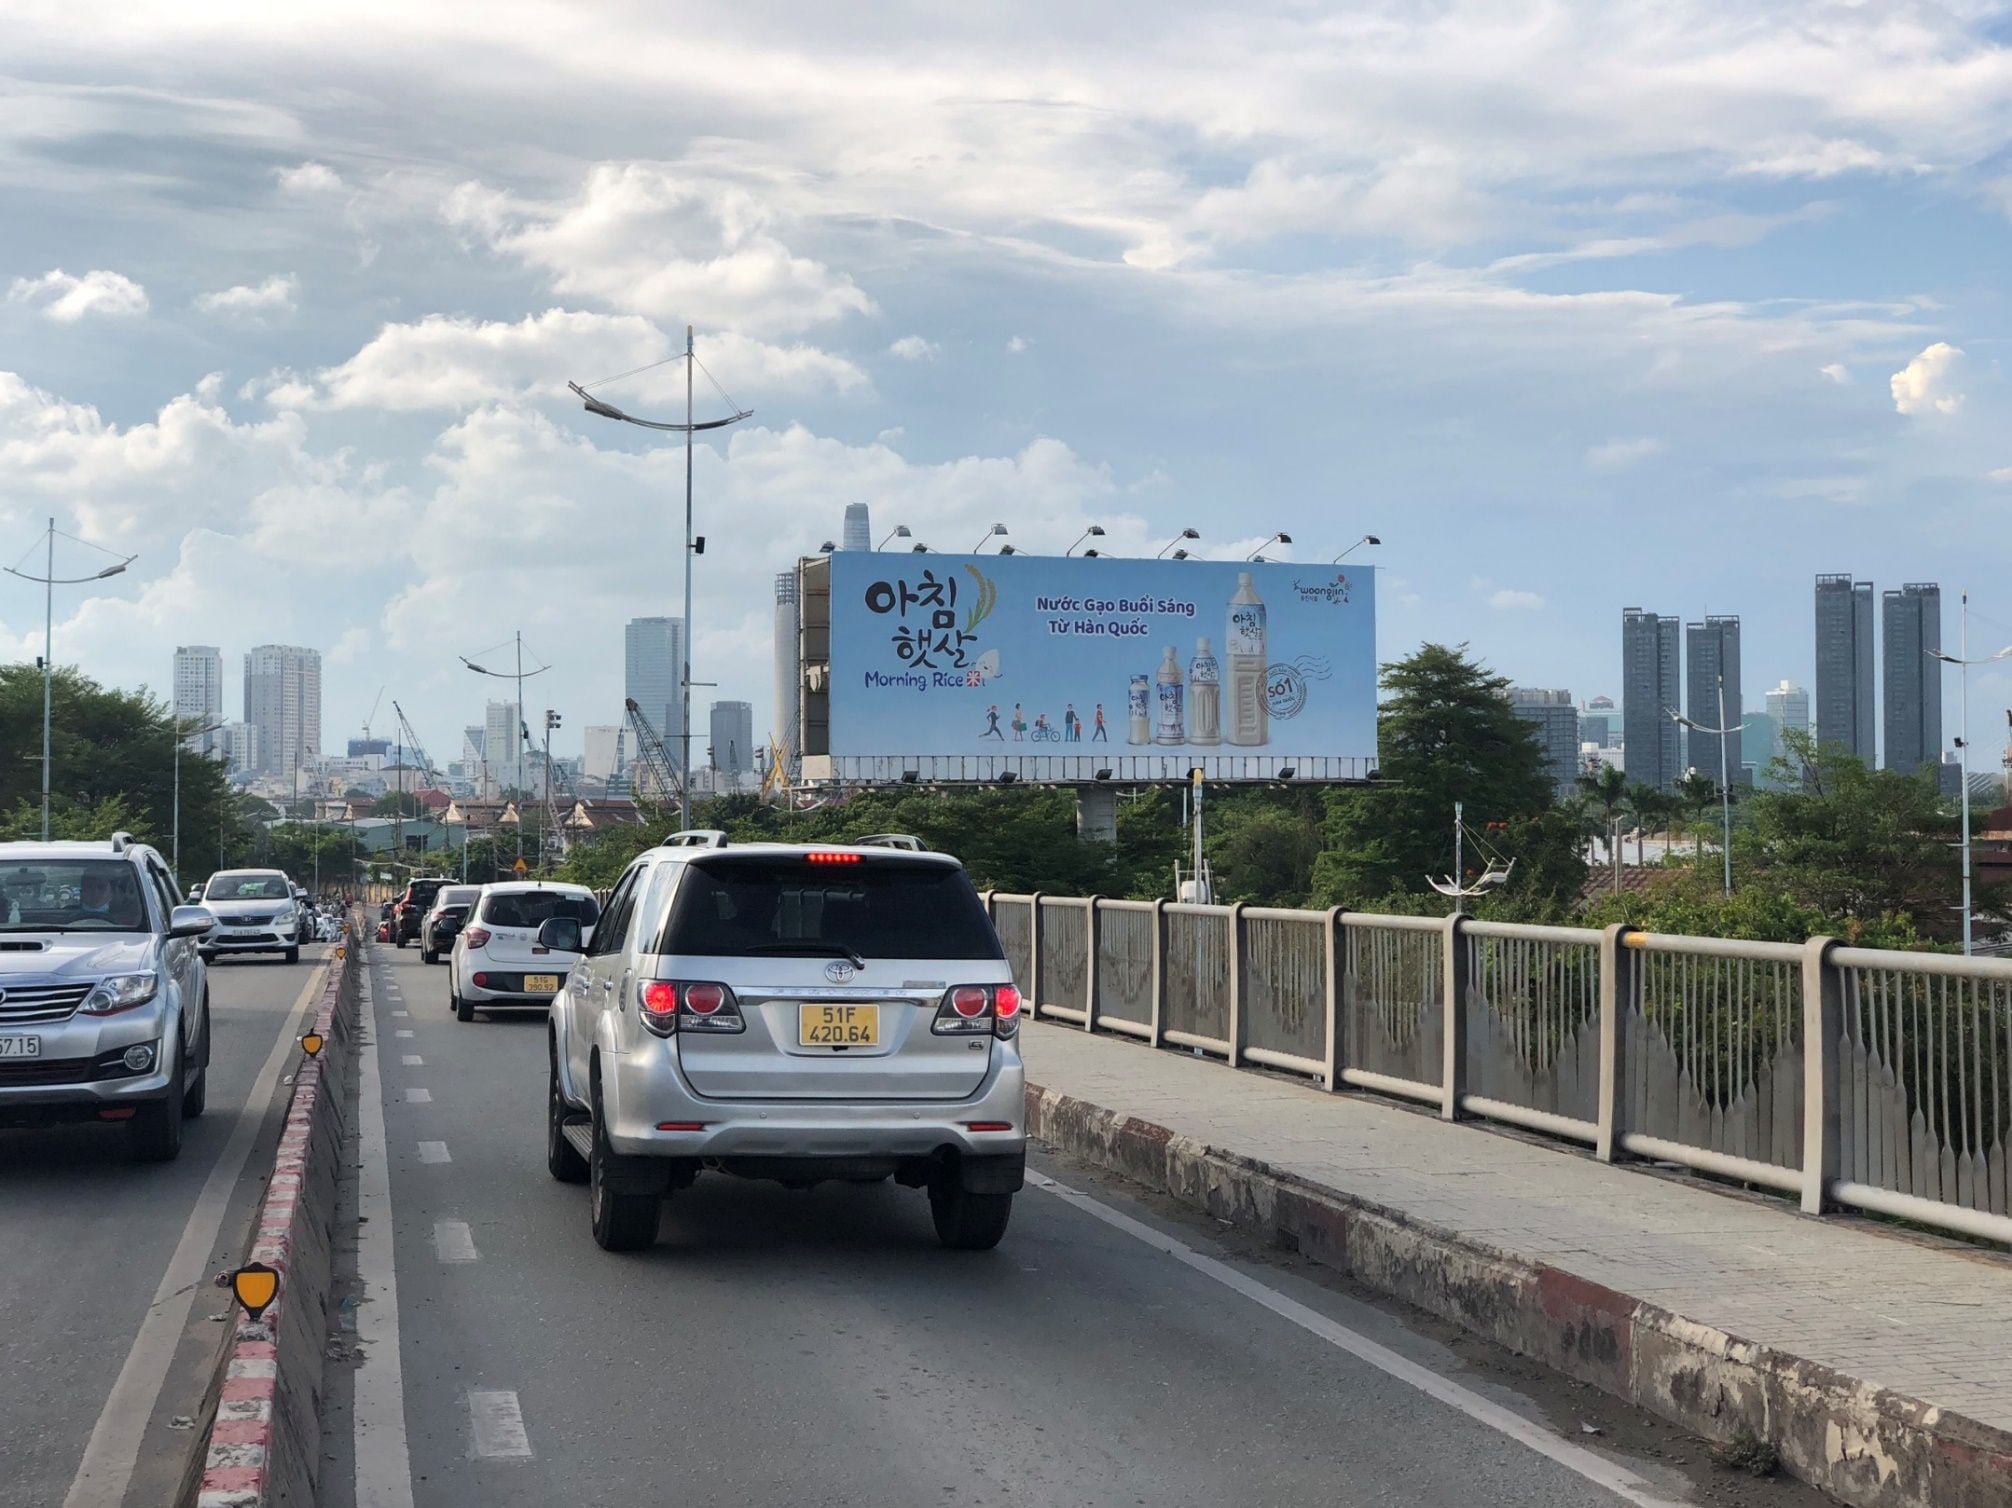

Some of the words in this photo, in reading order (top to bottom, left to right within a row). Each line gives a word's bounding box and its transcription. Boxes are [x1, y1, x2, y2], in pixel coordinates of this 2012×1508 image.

[865, 569, 957, 629] 아침
[1037, 596, 1080, 611] Nước
[1084, 598, 1115, 616] Gạo
[1119, 594, 1153, 613] Buổi
[1157, 598, 1195, 617] Sáng
[1049, 618, 1070, 634] Từ
[1074, 618, 1105, 634] Hàn
[1108, 617, 1148, 637] Quốc
[891, 626, 978, 669] 햇살
[865, 670, 928, 692] Morning
[933, 671, 964, 688] Rice
[823, 1007, 856, 1024] 51F
[809, 1026, 871, 1043] 420.64
